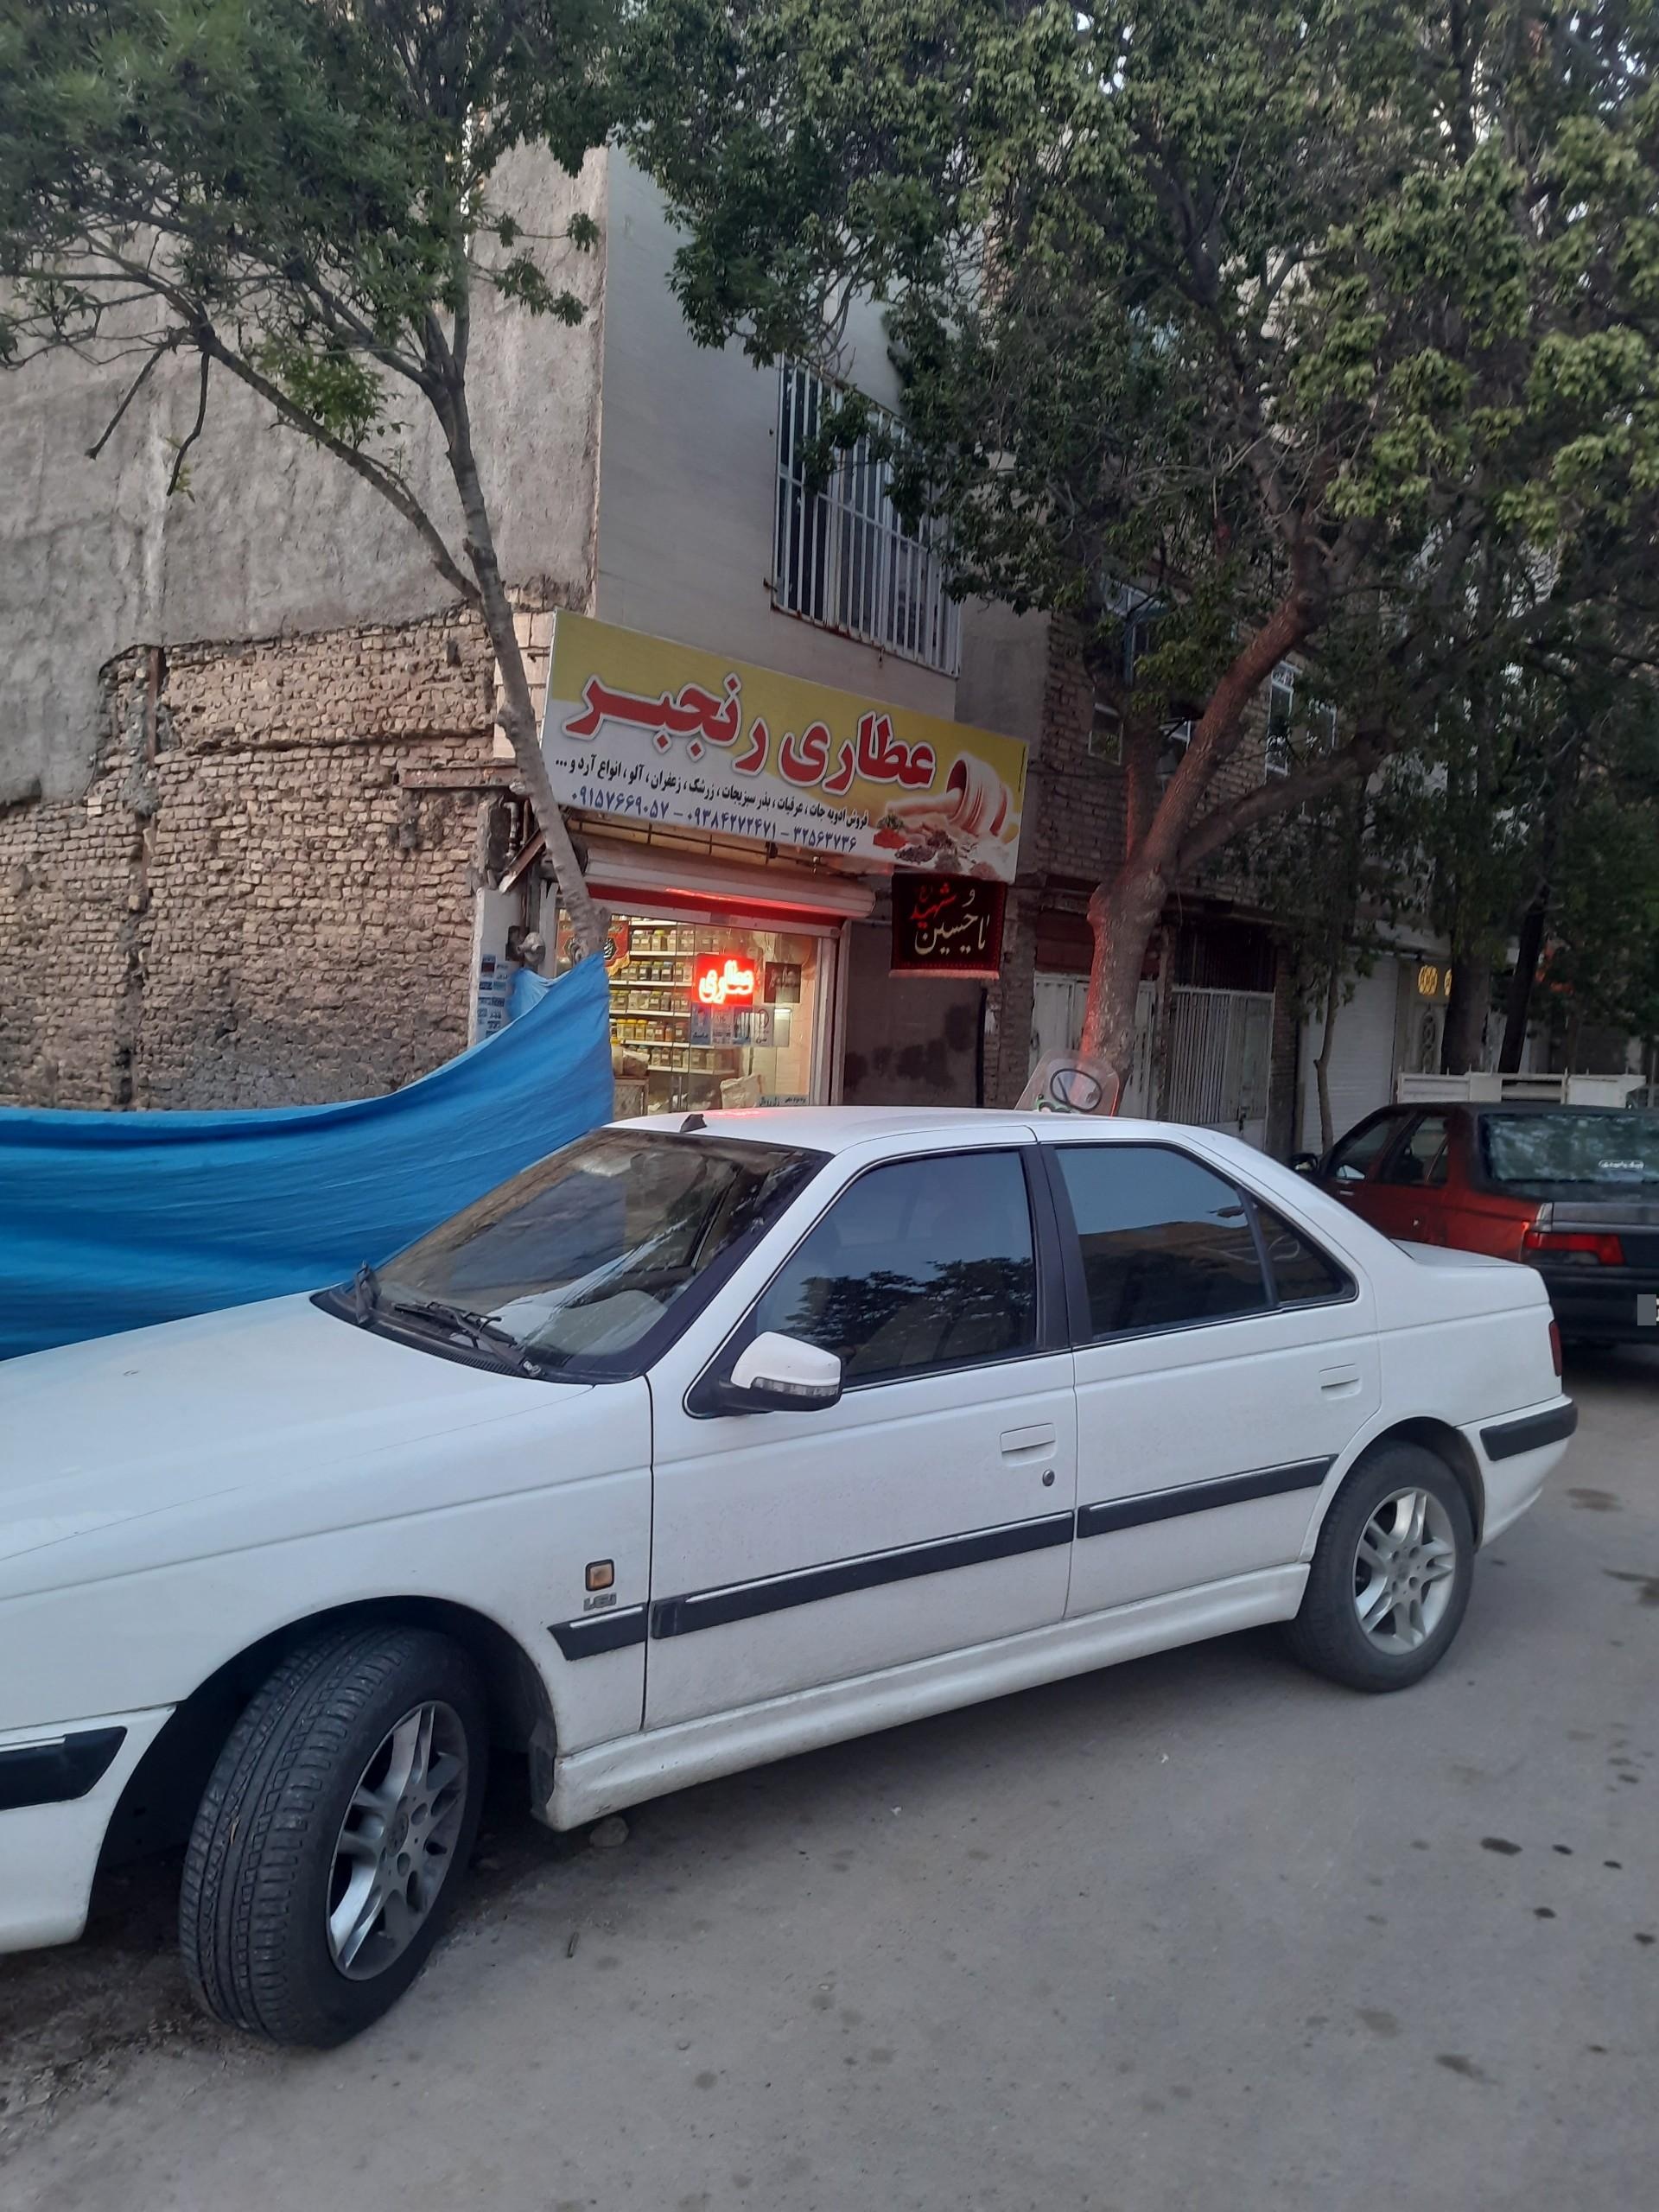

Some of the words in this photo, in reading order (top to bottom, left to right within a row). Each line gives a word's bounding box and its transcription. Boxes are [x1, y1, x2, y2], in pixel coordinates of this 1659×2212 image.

[563, 671, 770, 777] رنجبر
[578, 753, 597, 776] آرد
[779, 711, 937, 795] عطاری
[569, 761, 575, 773] و
[597, 758, 621, 779] انواع
[628, 763, 644, 785] آلو
[651, 770, 682, 794] زعفران
[689, 777, 715, 801] زرشک
[572, 785, 670, 820] ۰۹۱۵۷۶۶۹۰۵۷
[721, 783, 755, 809] سبزیجات
[757, 791, 771, 810] بذر
[777, 794, 803, 817] عرقیات
[809, 803, 825, 821] جات
[827, 809, 846, 826] ادویه
[846, 808, 868, 830] فروش
